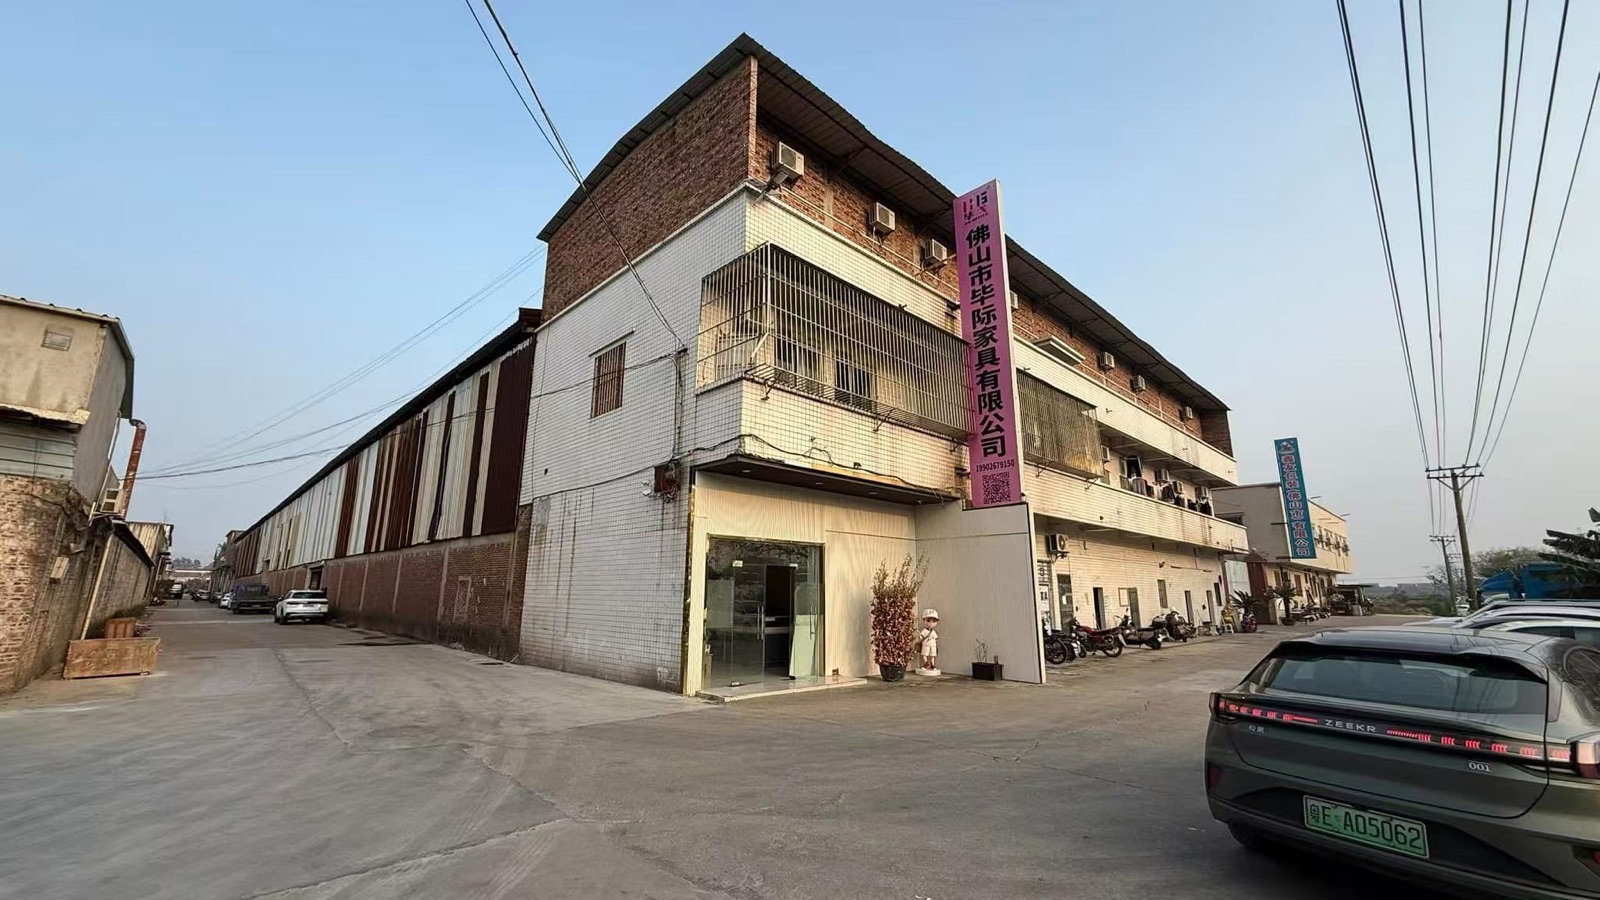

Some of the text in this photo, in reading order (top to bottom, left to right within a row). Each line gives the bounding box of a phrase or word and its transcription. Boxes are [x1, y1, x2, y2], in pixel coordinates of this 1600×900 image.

[966, 224, 1006, 458] 佛山市毕际家具有限公司
[976, 459, 1015, 472] 19902679150
[1325, 719, 1376, 732] ZEEKR
[1468, 762, 1491, 772] 001
